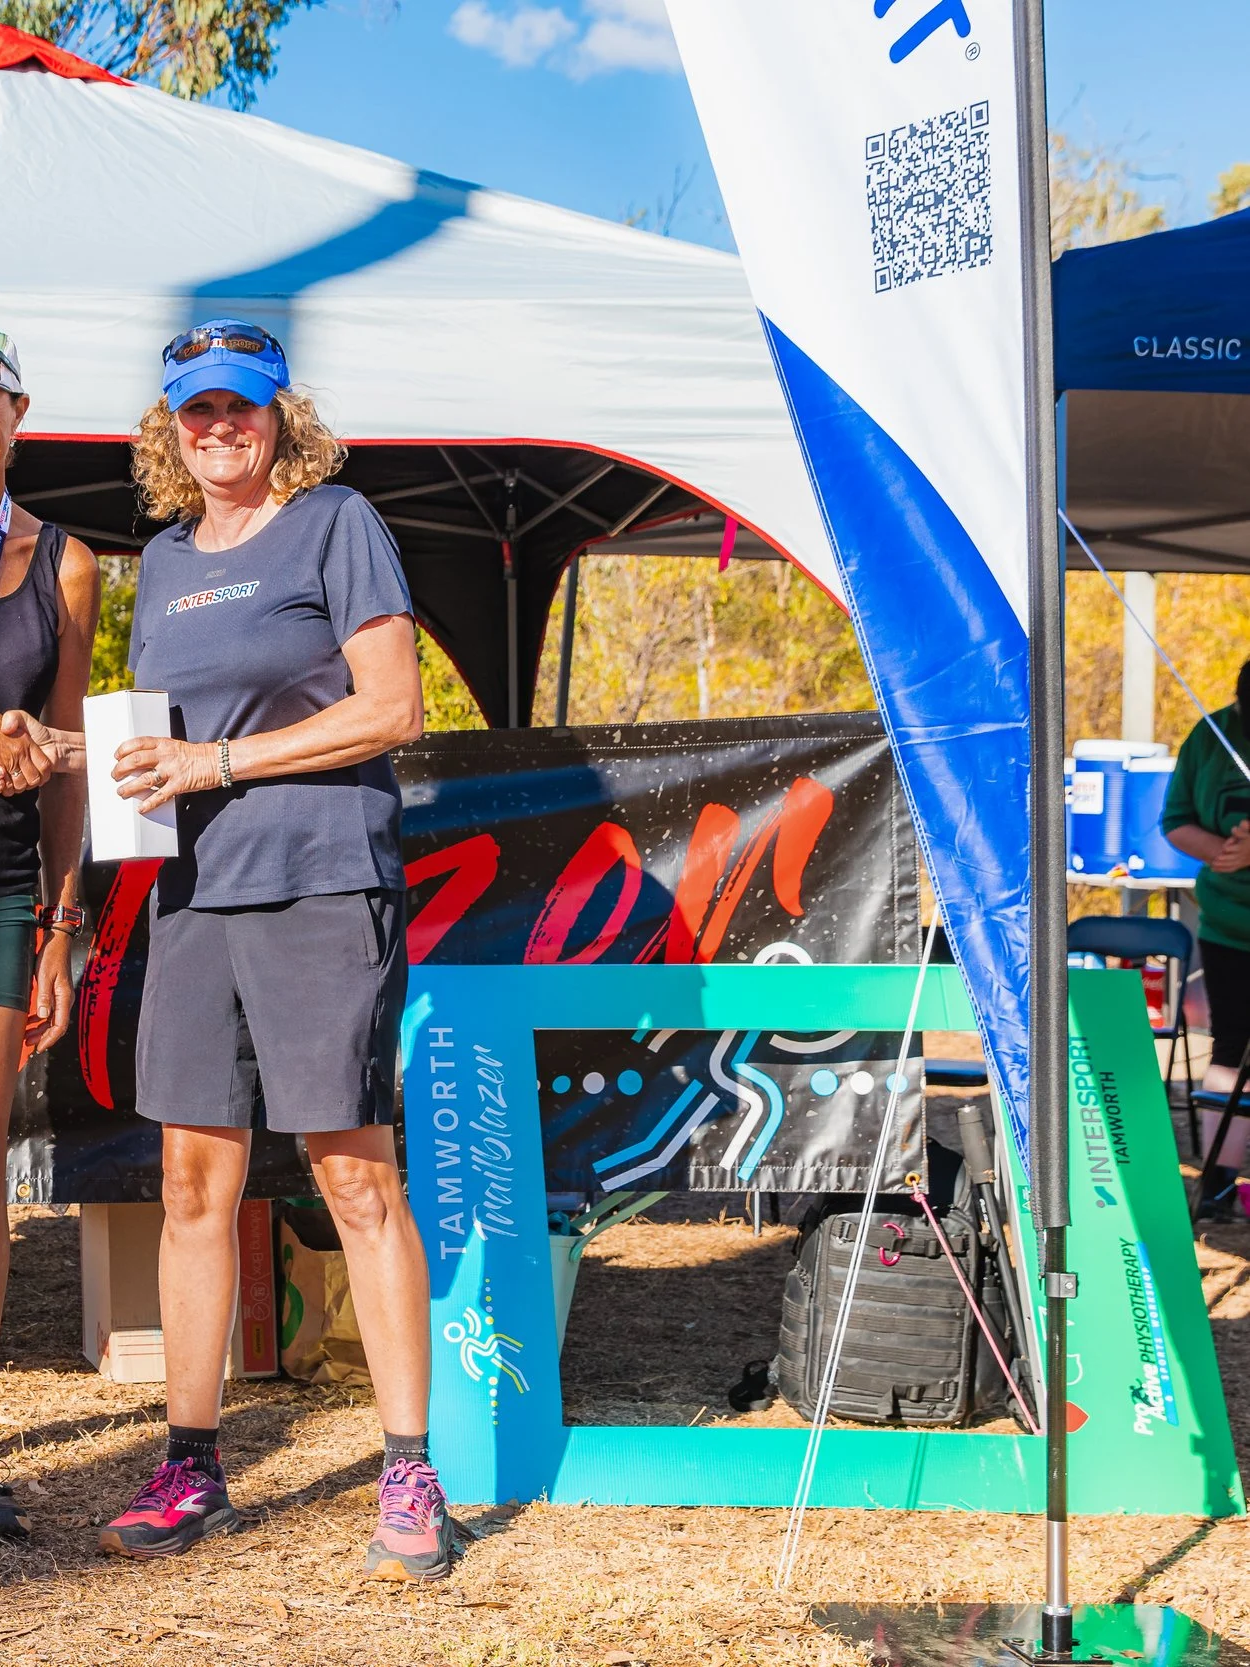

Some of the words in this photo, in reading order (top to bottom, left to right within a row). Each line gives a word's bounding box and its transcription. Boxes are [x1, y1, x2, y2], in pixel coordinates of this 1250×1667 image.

[1133, 336, 1241, 360] CLASSIC
[175, 581, 260, 613] INTERSPORT
[1070, 1036, 1113, 1183] INTERSPORT
[1099, 1071, 1131, 1164] TAMWORTH
[429, 1027, 467, 1260] TAMWORTH
[469, 1044, 519, 1242] Trailblazer
[1119, 1237, 1155, 1364] PHYSIOTHERAPY
[1142, 1267, 1160, 1328] WORKSHOP
[1154, 1337, 1170, 1381] SPORTS
[1133, 1402, 1154, 1436] Pro
[1142, 1364, 1167, 1421] Active
